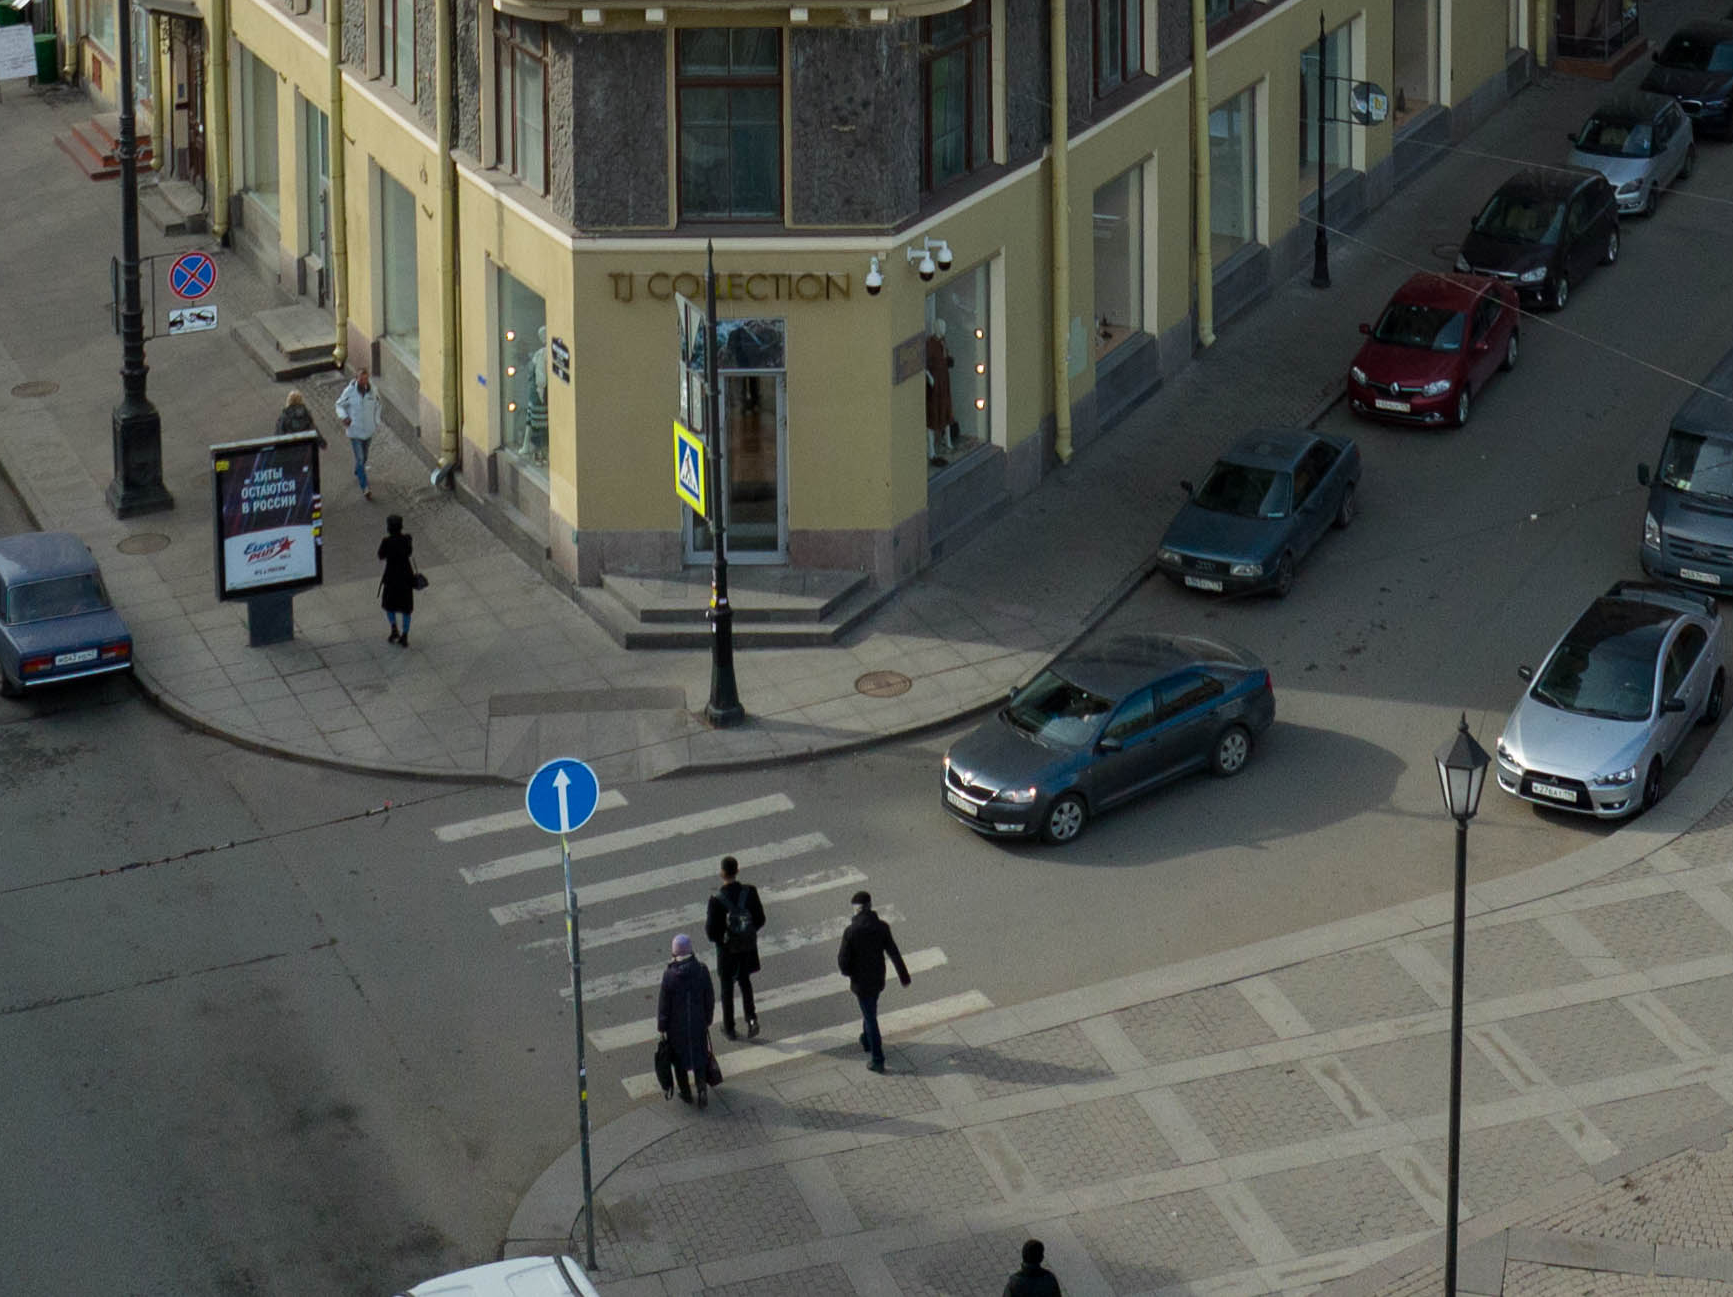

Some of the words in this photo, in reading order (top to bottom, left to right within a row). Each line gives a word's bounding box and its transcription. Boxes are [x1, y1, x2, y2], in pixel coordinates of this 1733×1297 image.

[608, 272, 634, 302] TJ
[647, 271, 852, 301] COLLECTION
[254, 466, 284, 482] ХИТЫ
[241, 479, 296, 500] ОСТАЮТСЯ
[241, 502, 250, 515] В
[253, 494, 297, 512] РОССИИ
